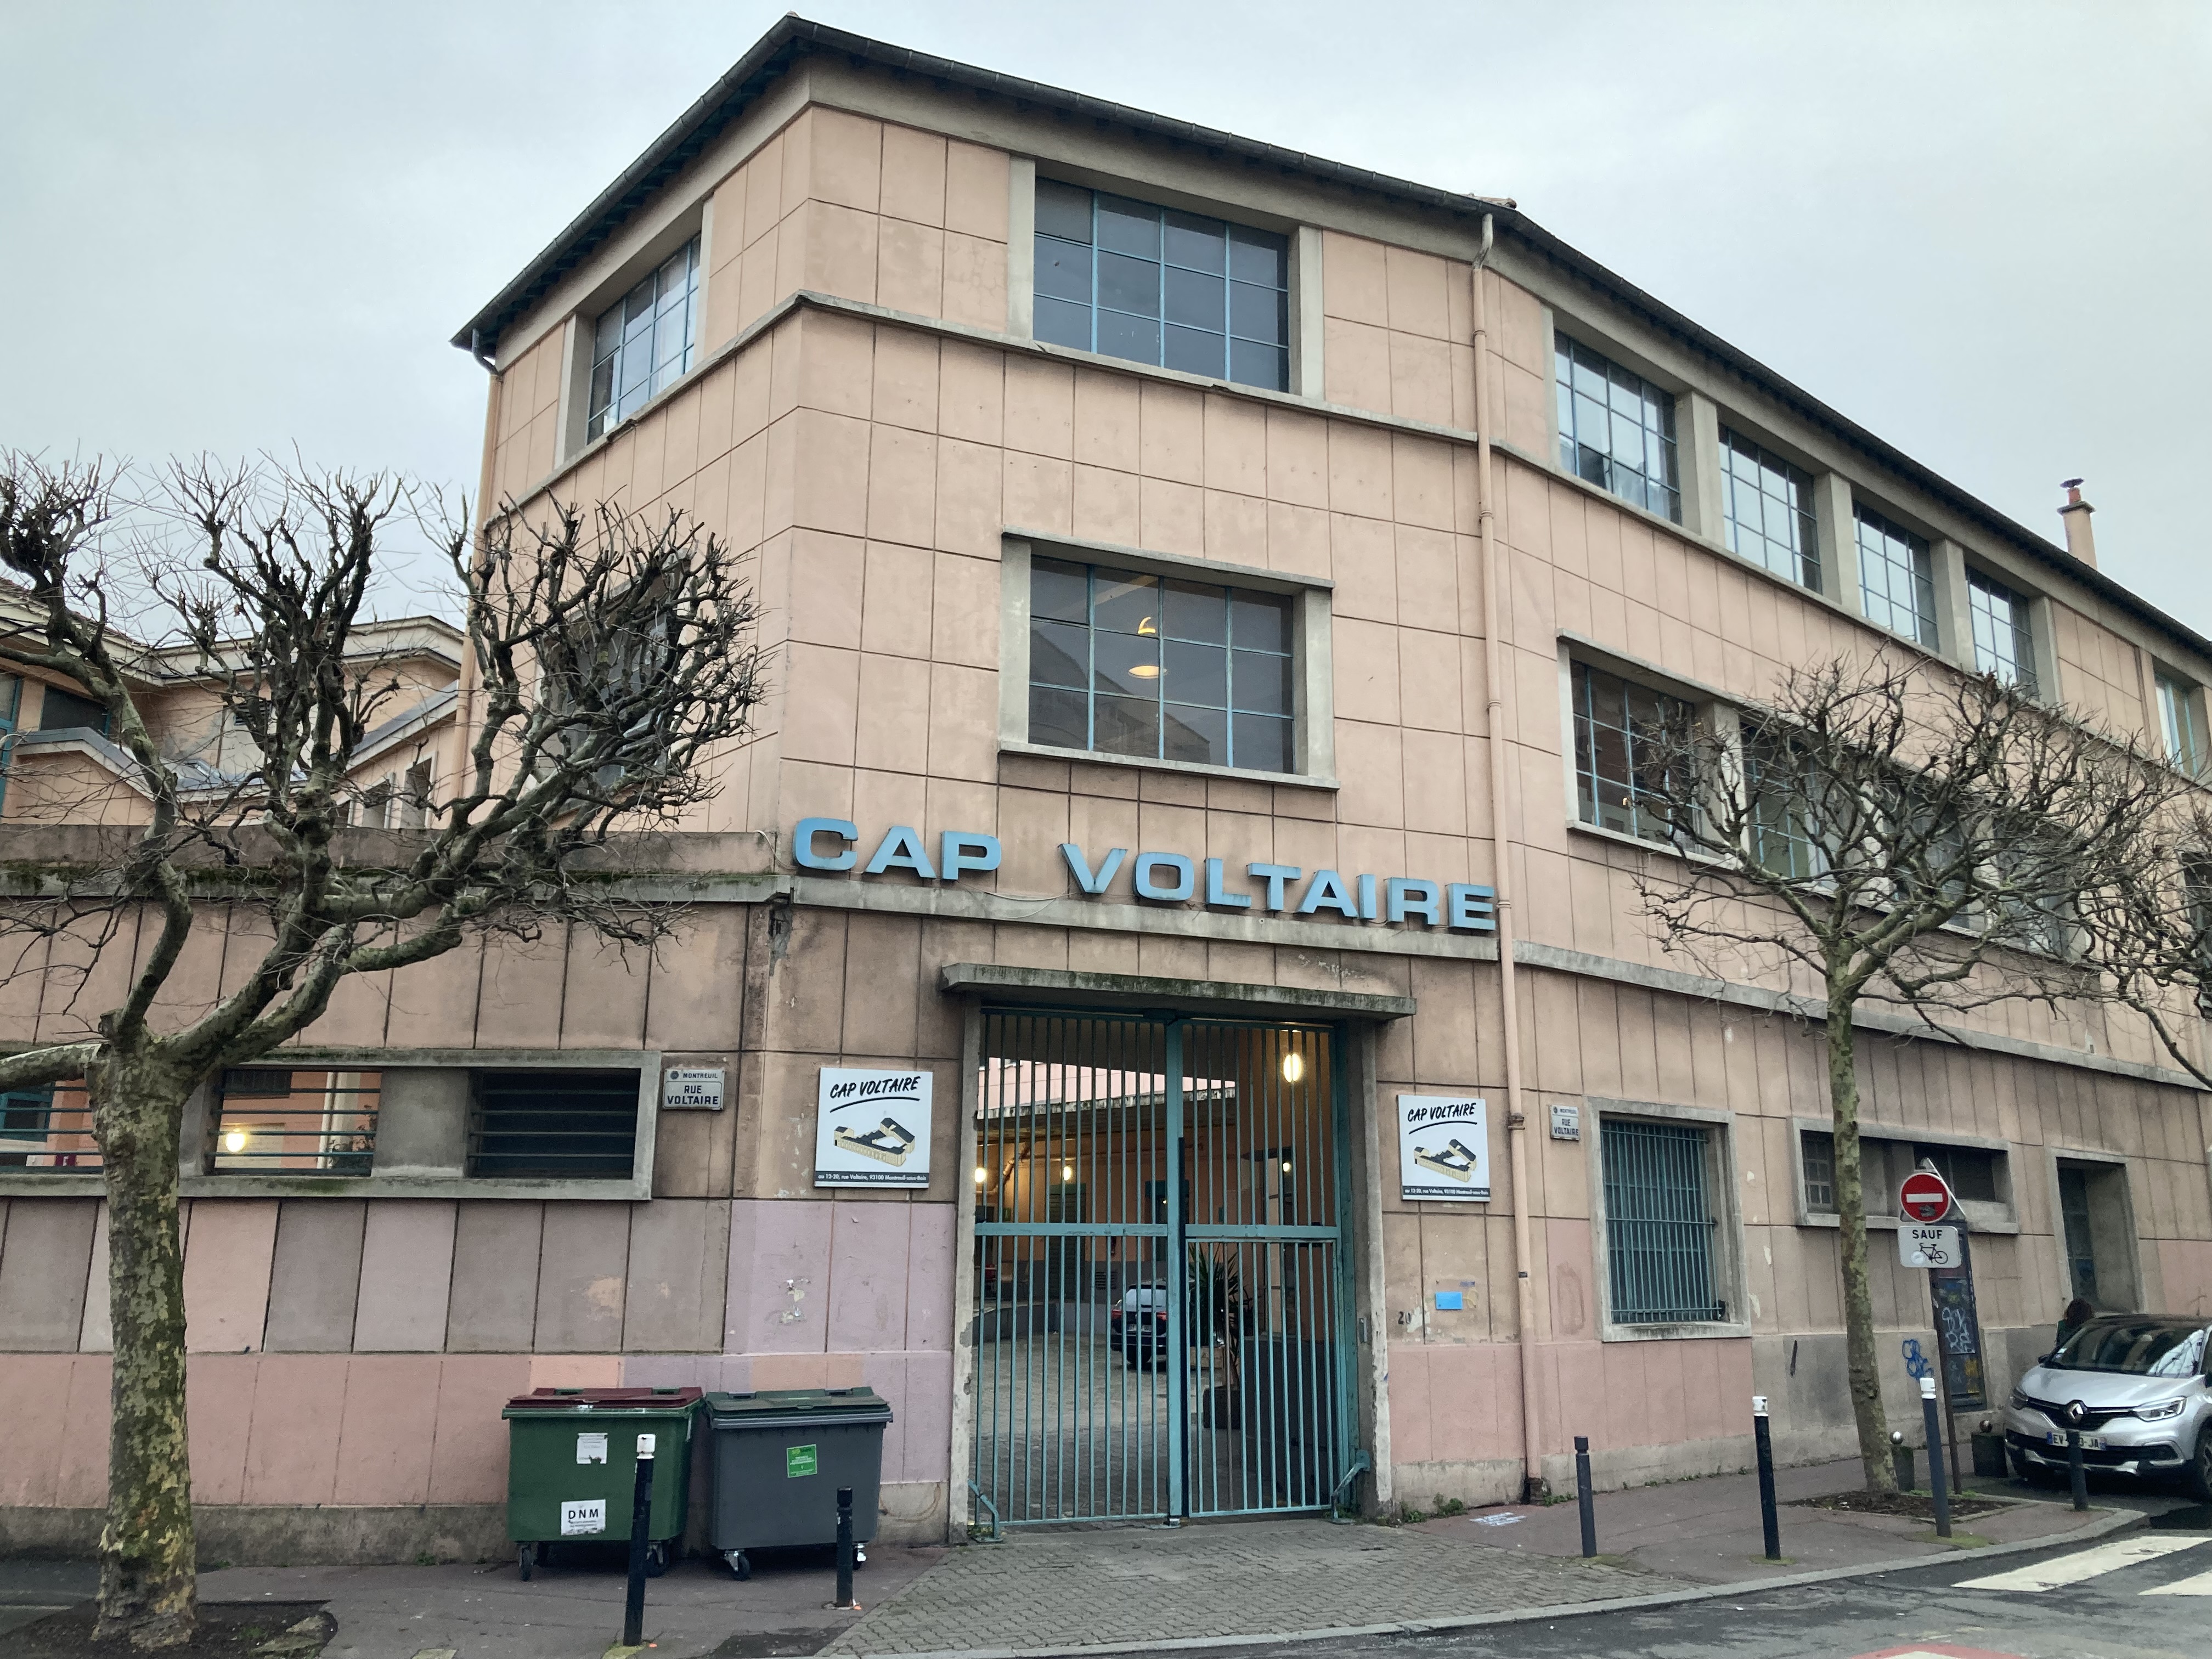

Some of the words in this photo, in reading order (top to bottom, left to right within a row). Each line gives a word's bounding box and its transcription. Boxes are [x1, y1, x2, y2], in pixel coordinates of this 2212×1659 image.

[792, 817, 1003, 881] CAP
[1059, 843, 1497, 932] VOLTAIRE
[684, 1085, 702, 1094] RUE
[830, 1082, 857, 1099] CAP
[859, 1076, 921, 1096] VOLTAIRE
[667, 1095, 719, 1105] VOLTAIRE
[1407, 1108, 1427, 1122] CAP
[1430, 1102, 1476, 1120] VOLTAIRE
[1554, 1126, 1579, 1136] VOLTAIRE
[1912, 1229, 1943, 1239] SAUF
[1398, 1311, 1411, 1325] 20
